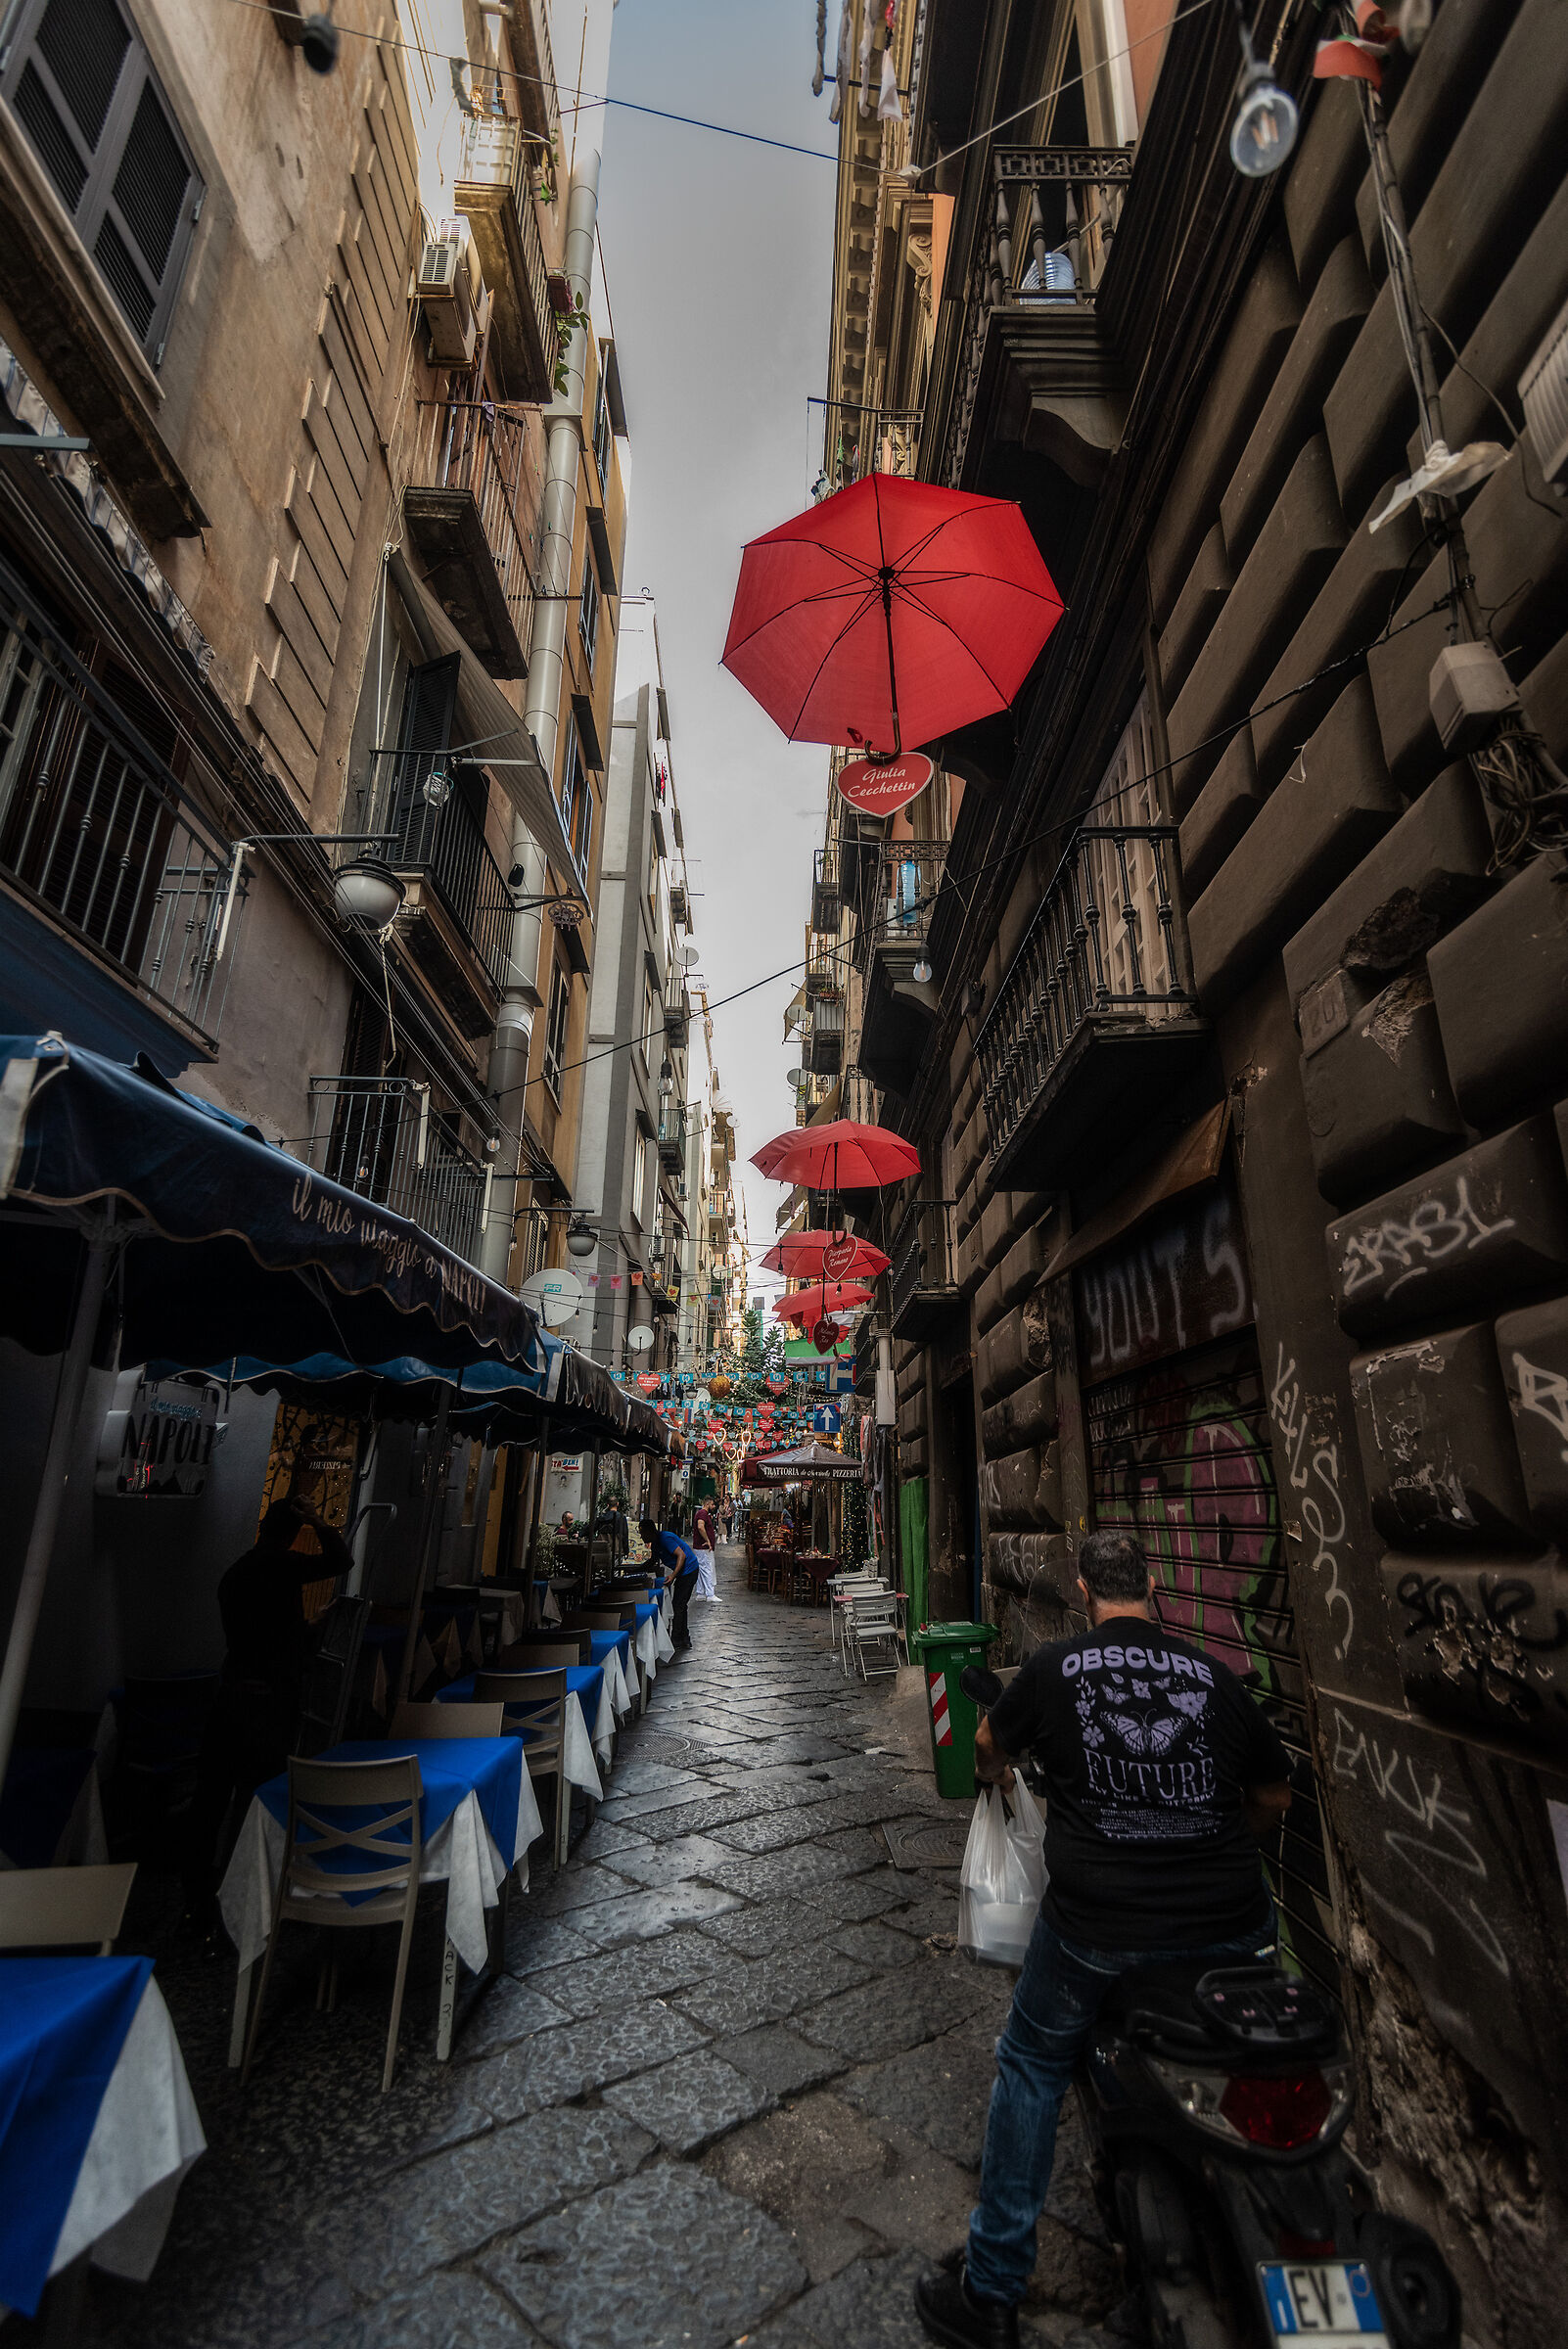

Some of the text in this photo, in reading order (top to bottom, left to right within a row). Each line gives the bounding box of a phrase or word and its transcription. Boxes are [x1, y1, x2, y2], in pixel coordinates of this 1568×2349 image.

[848, 781, 915, 798] Cecchettin
[862, 767, 906, 783] Giulia
[317, 1195, 355, 1234] mio
[360, 1219, 422, 1278] viaggio
[121, 1412, 214, 1466] NAPOLI
[763, 1467, 800, 1476] TRATTORIA
[832, 1469, 862, 1478] PIZZERIA
[1061, 1645, 1215, 1688] OBSCURE
[1082, 1747, 1217, 1799] FUTURE
[1288, 2268, 1334, 2328] EV
